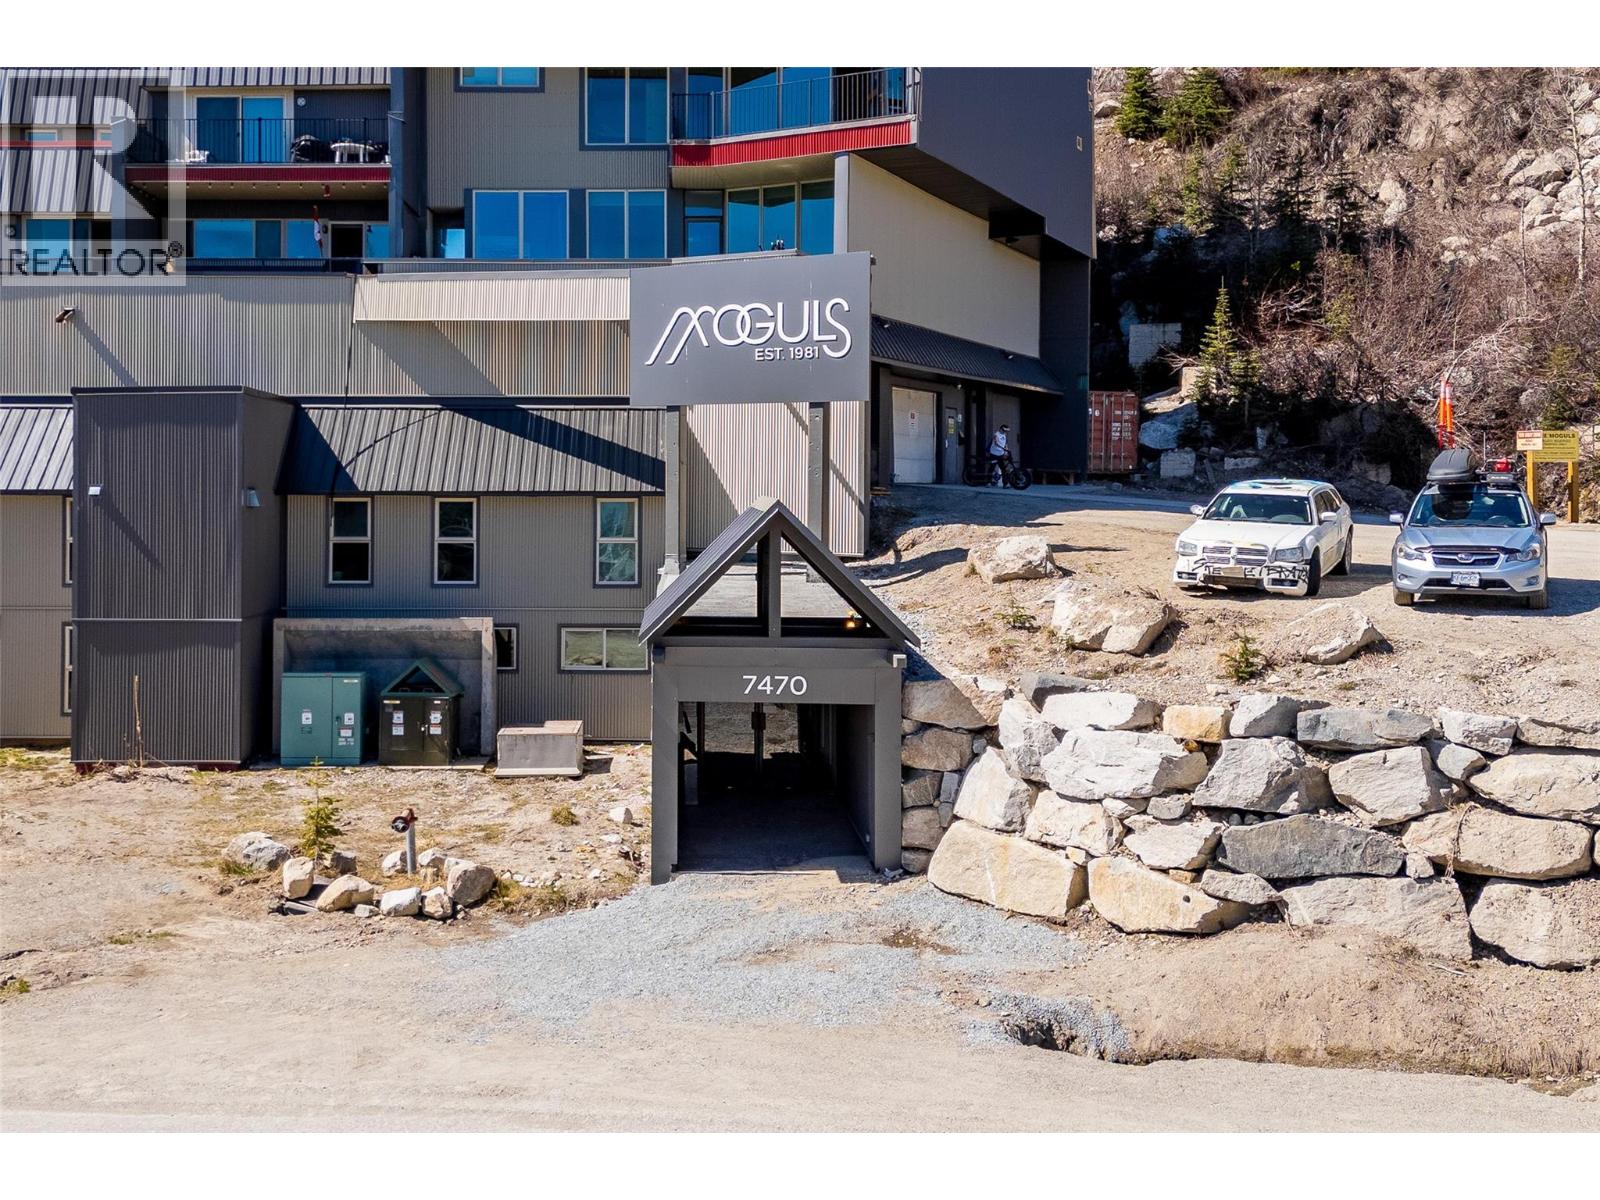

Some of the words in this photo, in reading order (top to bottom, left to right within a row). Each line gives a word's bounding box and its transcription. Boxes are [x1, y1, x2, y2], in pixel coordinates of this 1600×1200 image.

[644, 298, 852, 365] MOGULS
[755, 347, 786, 361] EST.
[790, 346, 820, 360] 1981
[742, 675, 808, 696] 7470
